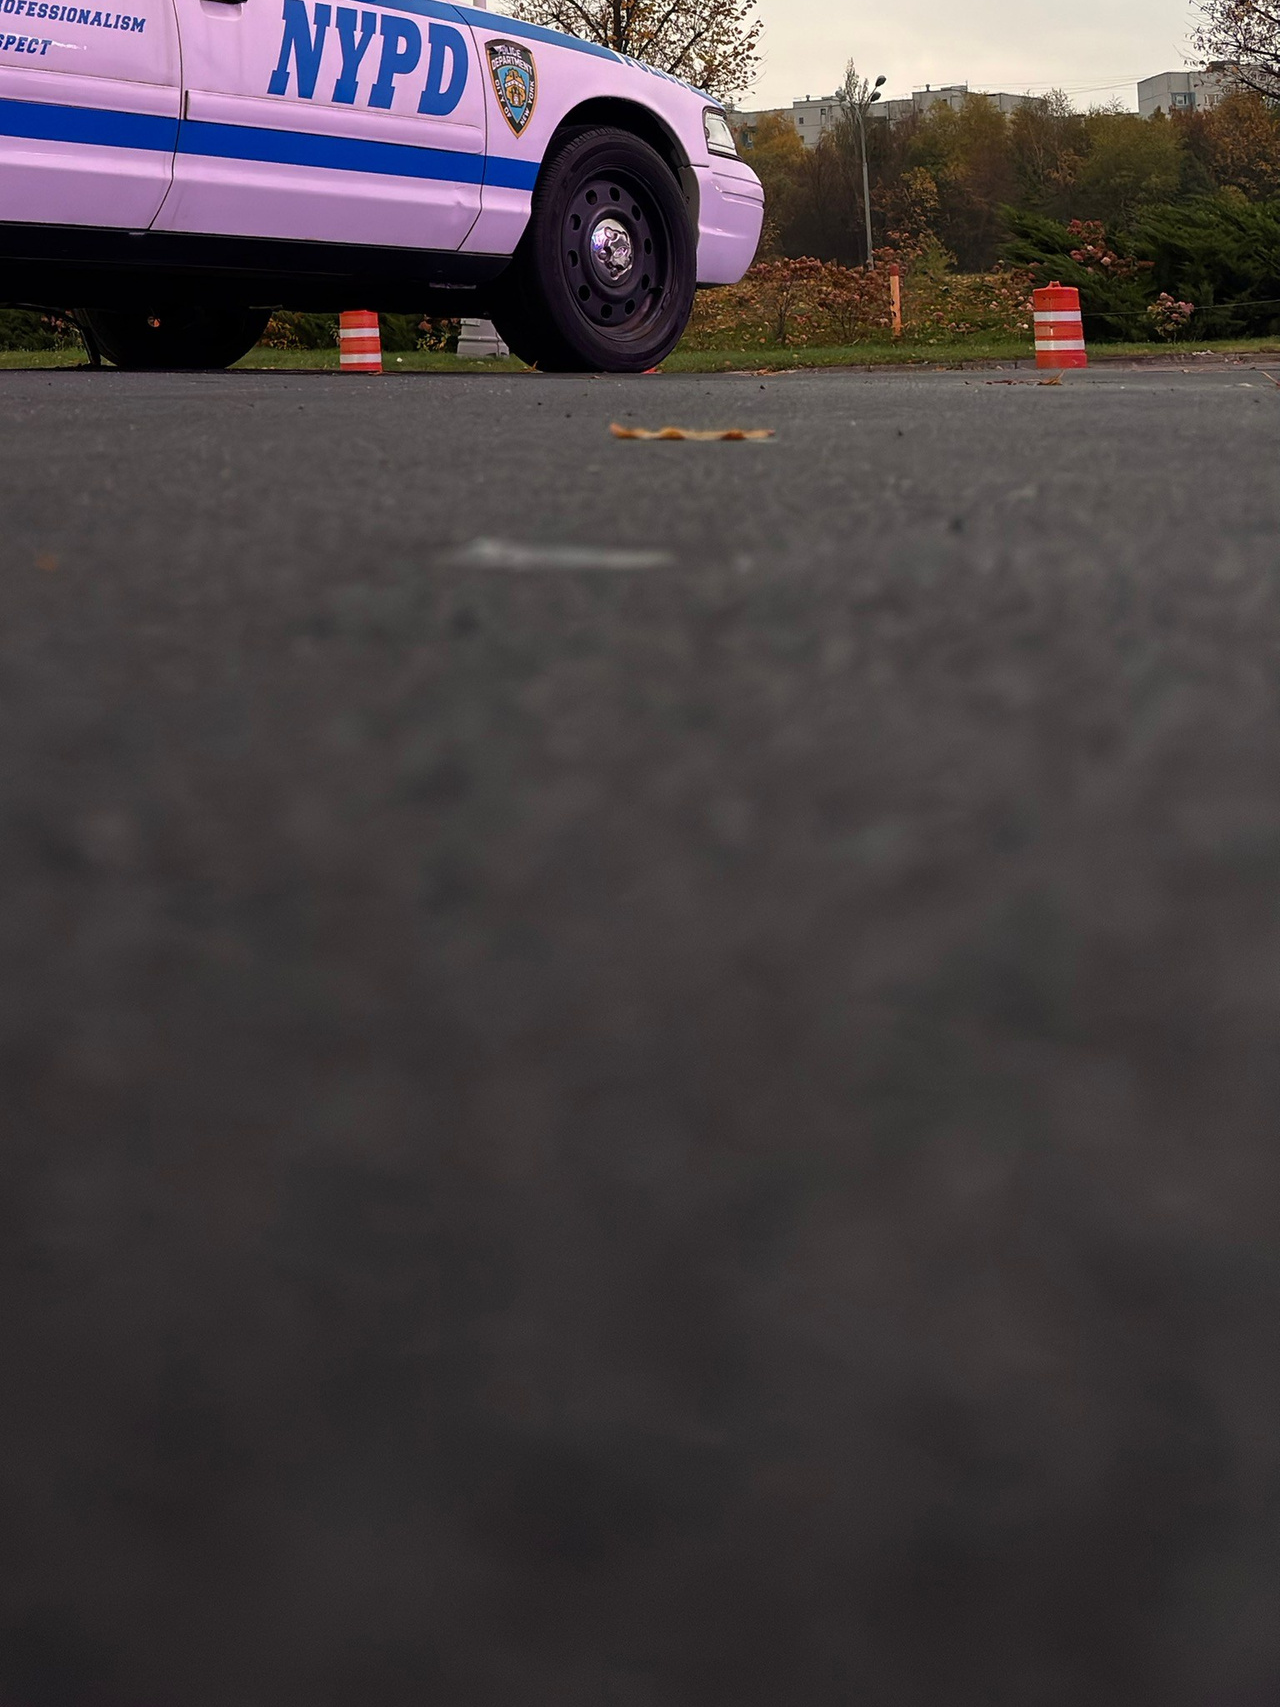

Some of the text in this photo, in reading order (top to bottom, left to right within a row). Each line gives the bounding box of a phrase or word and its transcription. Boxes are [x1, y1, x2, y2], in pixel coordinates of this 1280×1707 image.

[491, 55, 533, 75] DEPARTMENT
[519, 107, 530, 127] NEW
[527, 80, 535, 105] YORK
